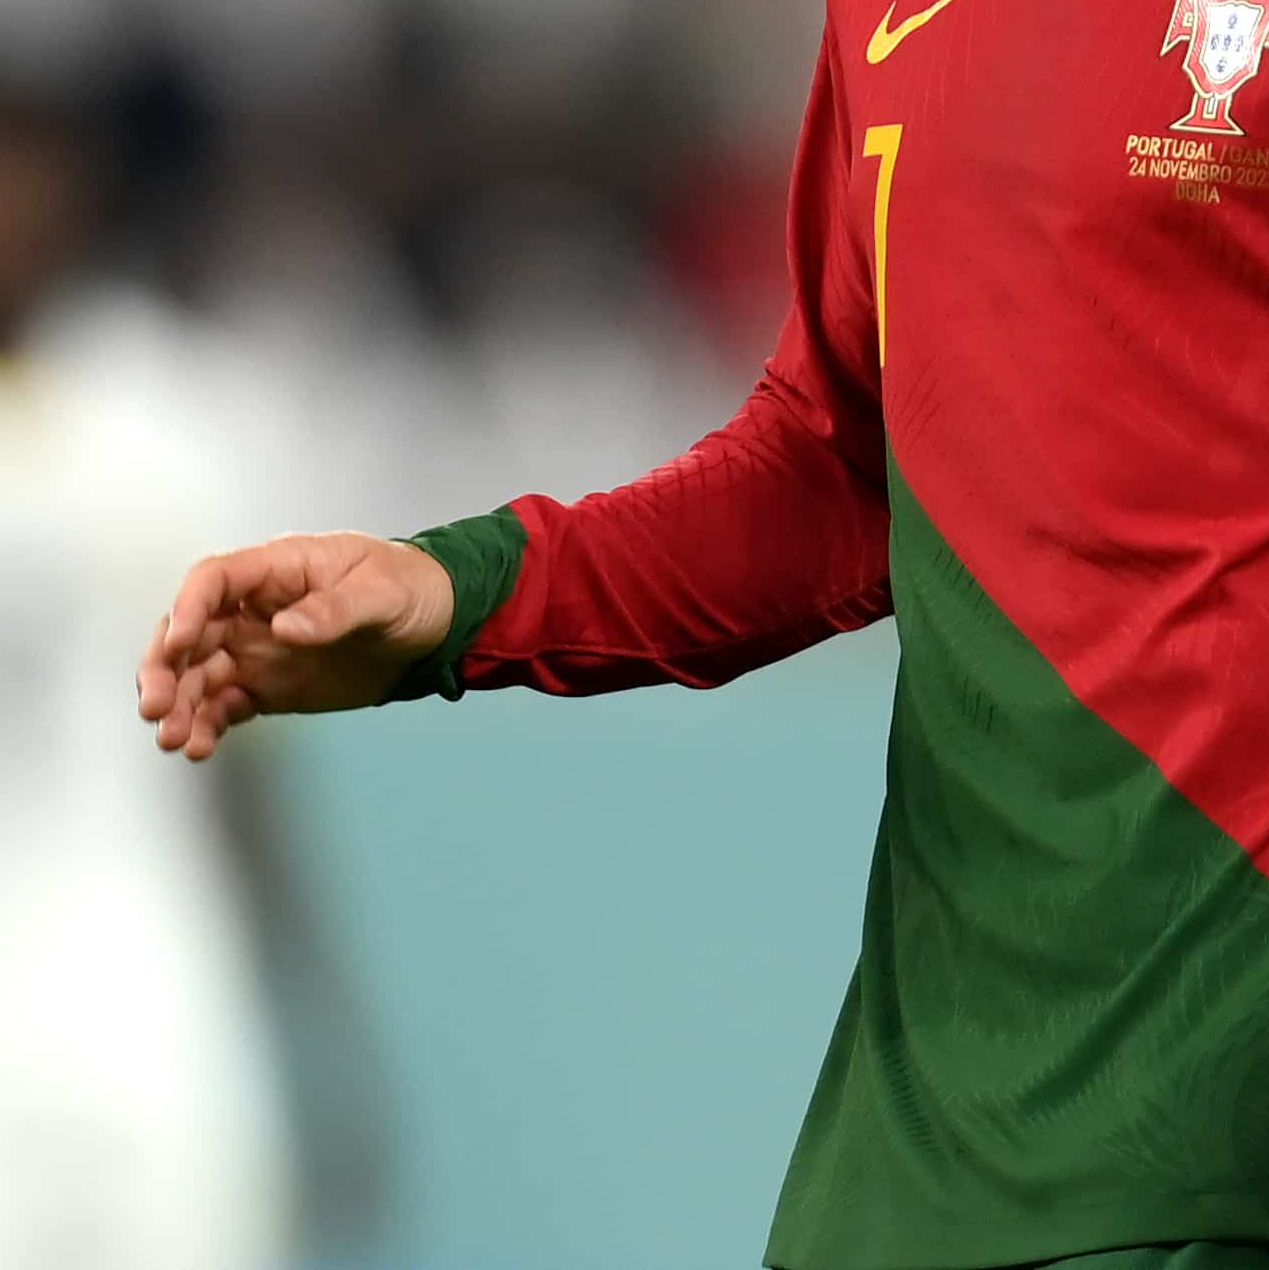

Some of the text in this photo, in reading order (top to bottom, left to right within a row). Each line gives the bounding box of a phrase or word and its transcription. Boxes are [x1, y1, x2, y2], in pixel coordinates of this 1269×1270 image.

[1126, 134, 1216, 162] PORTUGAL
[1129, 157, 1146, 177] 24
[1149, 158, 1231, 183] NOVEMBRO
[1176, 182, 1220, 203] DOHA
[862, 123, 903, 368] 7
